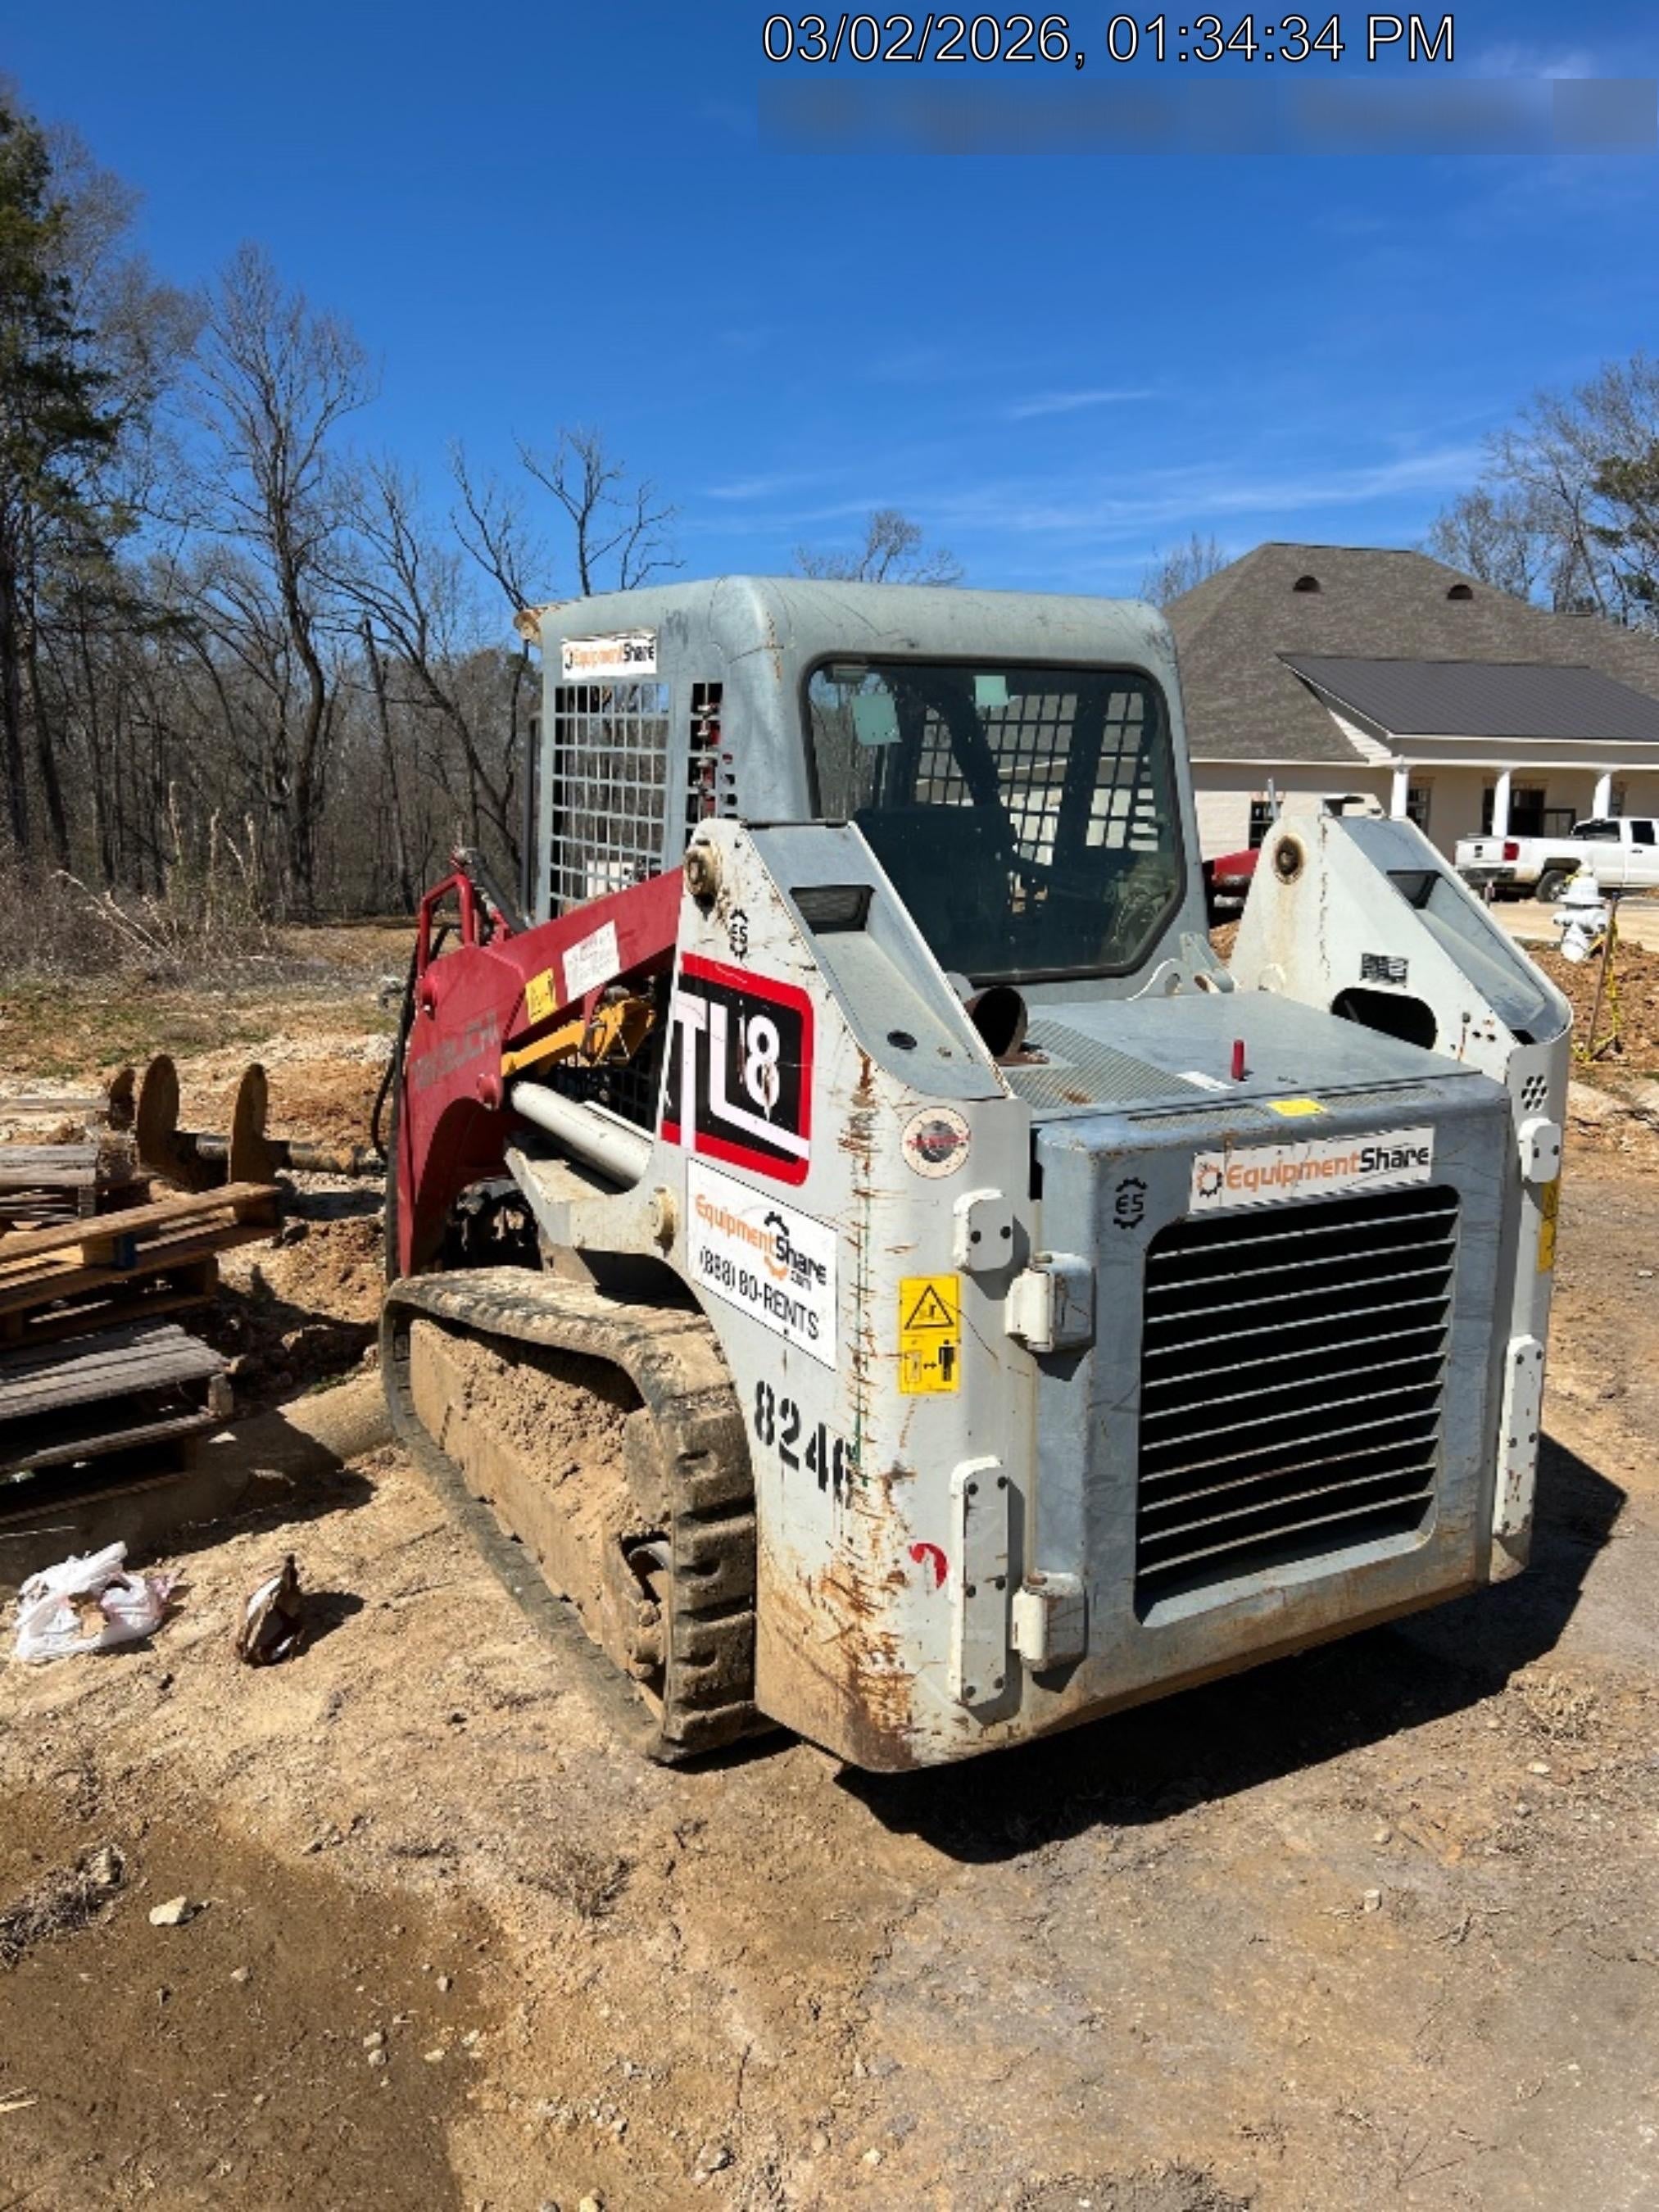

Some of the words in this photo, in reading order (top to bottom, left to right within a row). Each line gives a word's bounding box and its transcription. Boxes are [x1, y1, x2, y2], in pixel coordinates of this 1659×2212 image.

[673, 989, 811, 1161] TL8
[1226, 1146, 1430, 1193] EquipmentShare
[739, 1269, 820, 1340] 80-RENTS
